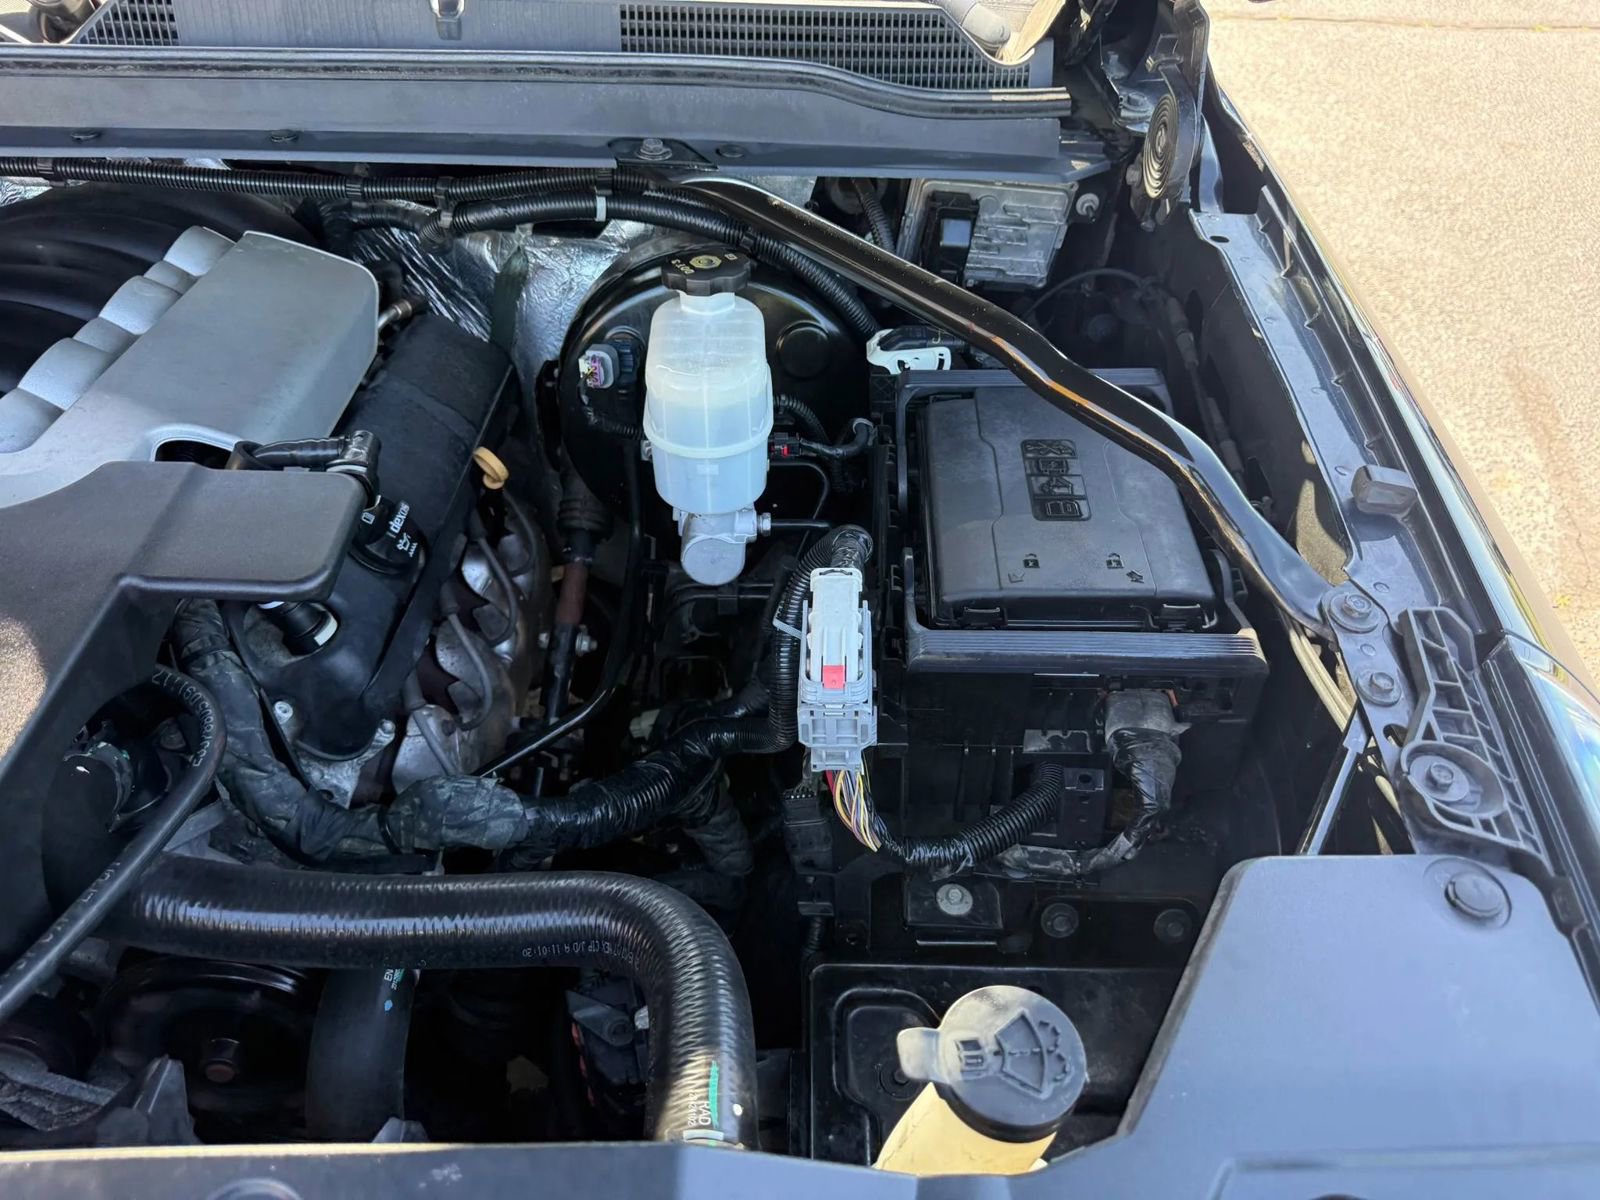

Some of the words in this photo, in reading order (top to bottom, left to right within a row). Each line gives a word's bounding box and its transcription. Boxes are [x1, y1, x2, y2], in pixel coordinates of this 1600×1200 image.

[675, 263, 695, 274] DOT
[388, 502, 410, 534] dexos
[698, 1100, 711, 1126] RAD
